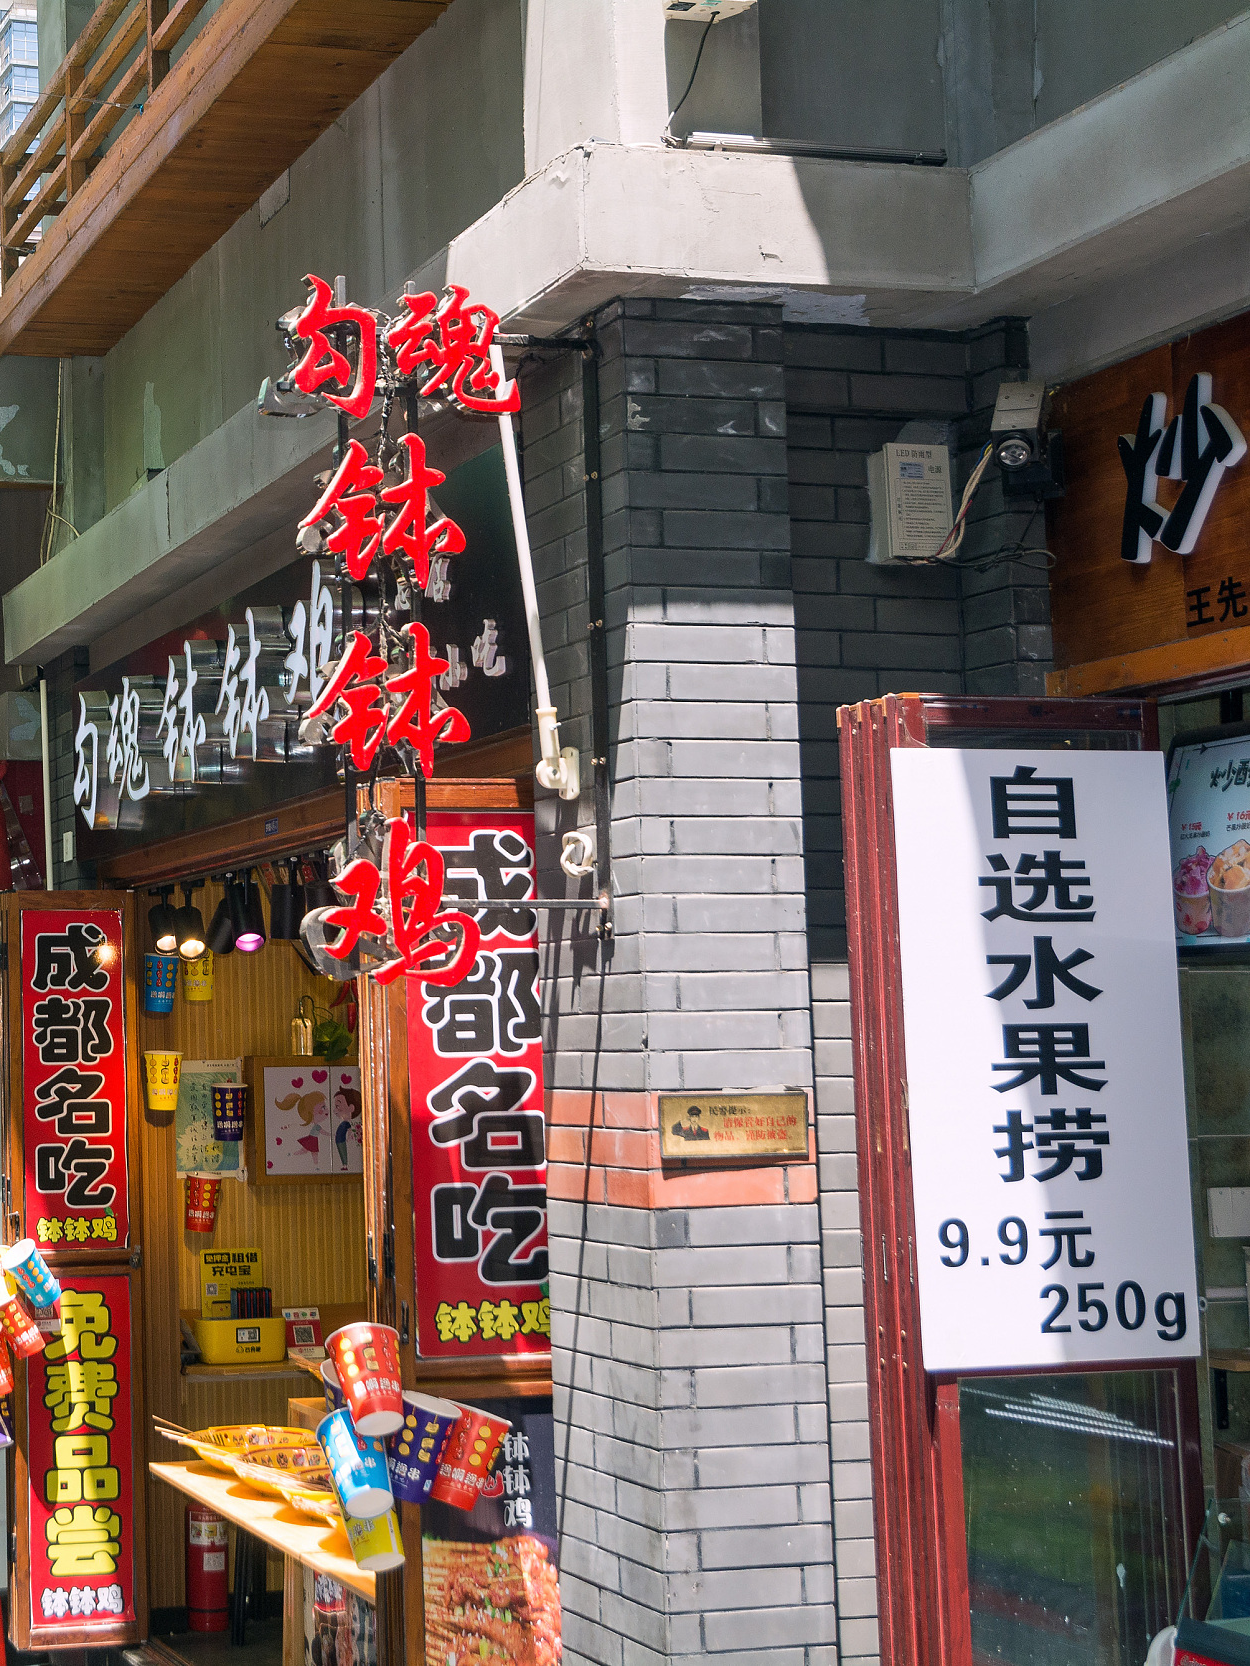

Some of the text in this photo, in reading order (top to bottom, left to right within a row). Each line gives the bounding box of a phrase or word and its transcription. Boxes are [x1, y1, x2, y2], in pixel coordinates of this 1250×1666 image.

[295, 273, 521, 419] 勾魂
[896, 449, 909, 457] LED
[1117, 371, 1248, 565] 炒
[1185, 575, 1250, 629] 王先
[978, 764, 1111, 1184] 自选水果捞
[31, 923, 118, 1208] 成都名吃
[36, 1215, 119, 1244] 钵钵鸡
[937, 1210, 1097, 1271] 9.9元
[211, 1265, 251, 1277] 充电宝
[1040, 1279, 1188, 1341] 250g
[43, 1288, 122, 1577] 免费品尝
[502, 1432, 533, 1528] 钵钵鸡
[40, 1584, 124, 1618] 钵钵鸡
